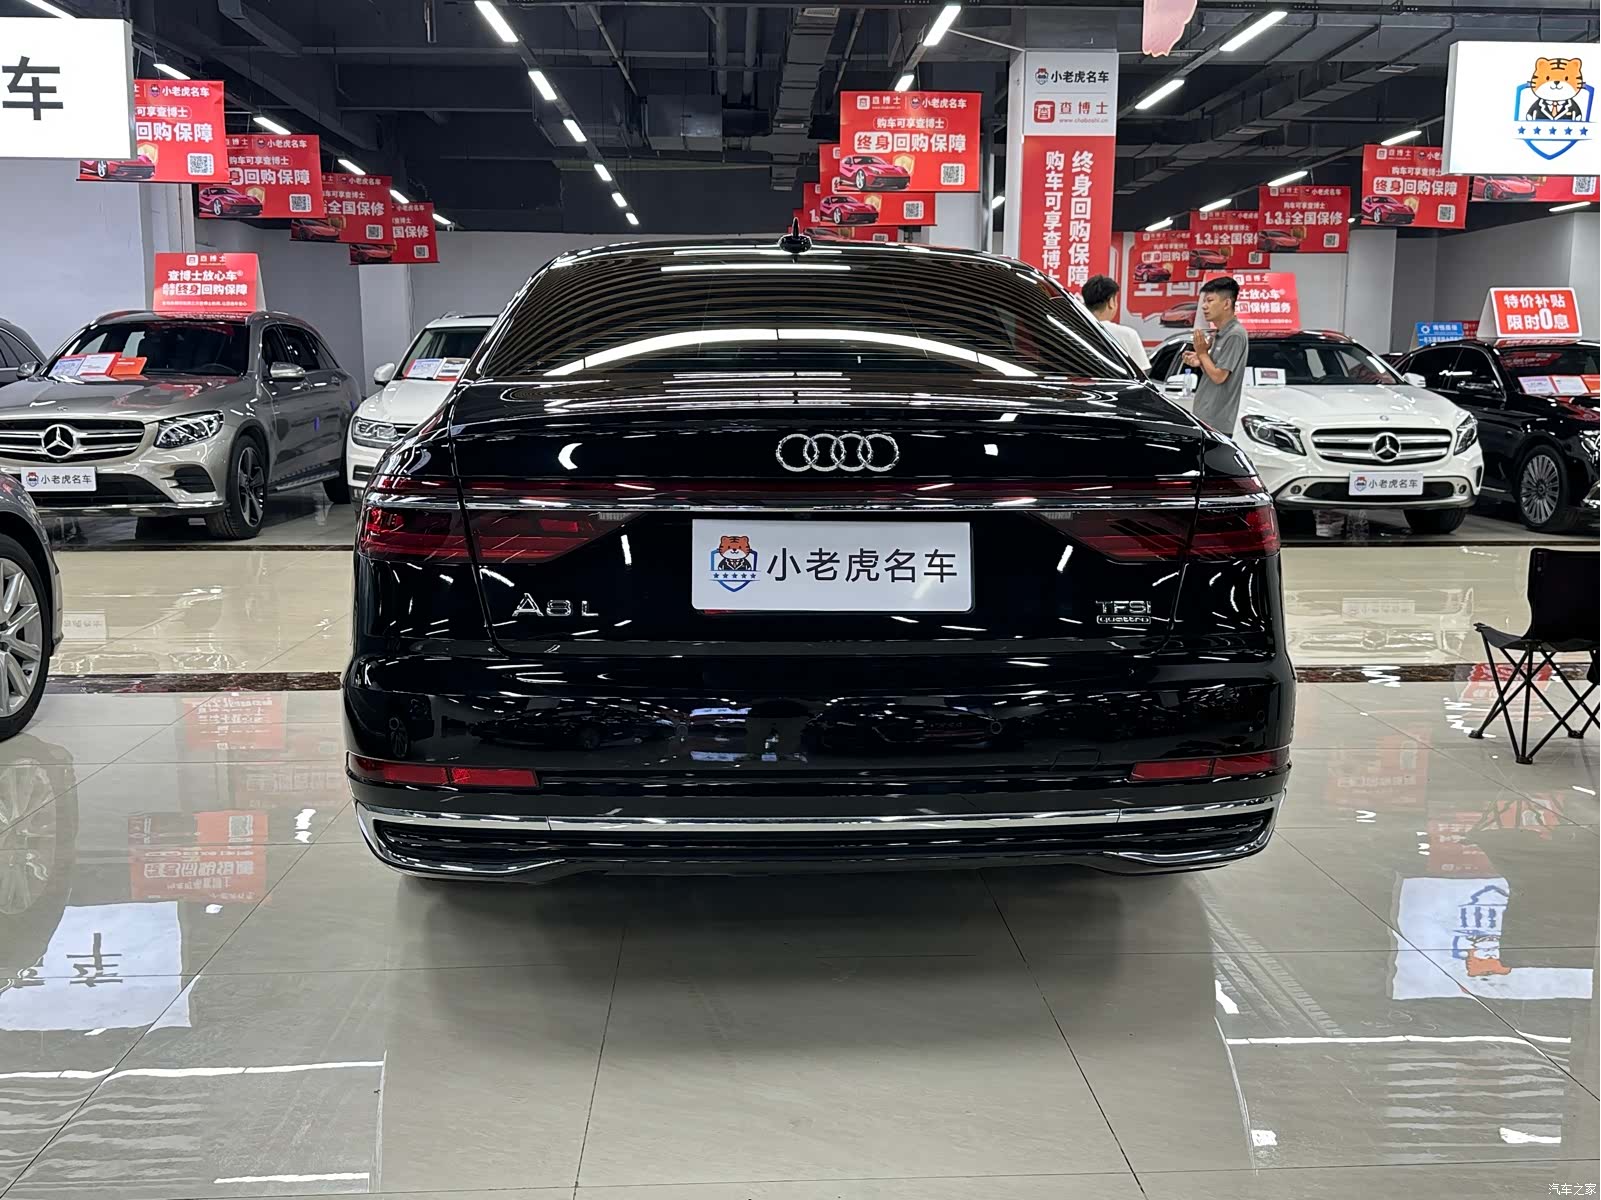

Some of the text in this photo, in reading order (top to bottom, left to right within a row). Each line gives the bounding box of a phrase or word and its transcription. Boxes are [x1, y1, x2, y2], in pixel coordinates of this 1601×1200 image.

[1051, 70, 1109, 83] 小老虎名车
[2, 56, 63, 120] 车
[162, 86, 210, 97] 小老虎名车
[922, 98, 967, 109] 小老虎名车
[1059, 101, 1109, 115] 查博士
[135, 106, 188, 118] 可享查博士
[877, 118, 944, 129] 购车可享查博士
[136, 122, 213, 142] 回购保障
[267, 139, 308, 149] 小老虎名车
[857, 133, 966, 153] 终身回购保障
[229, 156, 289, 166] 购车可享查博士
[1375, 180, 1458, 196] 终身回购保障
[1068, 150, 1094, 299] 终身回购保障
[1504, 293, 1567, 309] 特价补贴
[1506, 308, 1570, 330] 限时0息
[41, 474, 92, 484] 小老虎名车
[1368, 479, 1418, 489] 小老虎名车
[766, 547, 958, 583] 小老虎名车
[581, 600, 599, 616] L
[1095, 600, 1152, 614] TFSI
[1099, 616, 1149, 624] quattro
